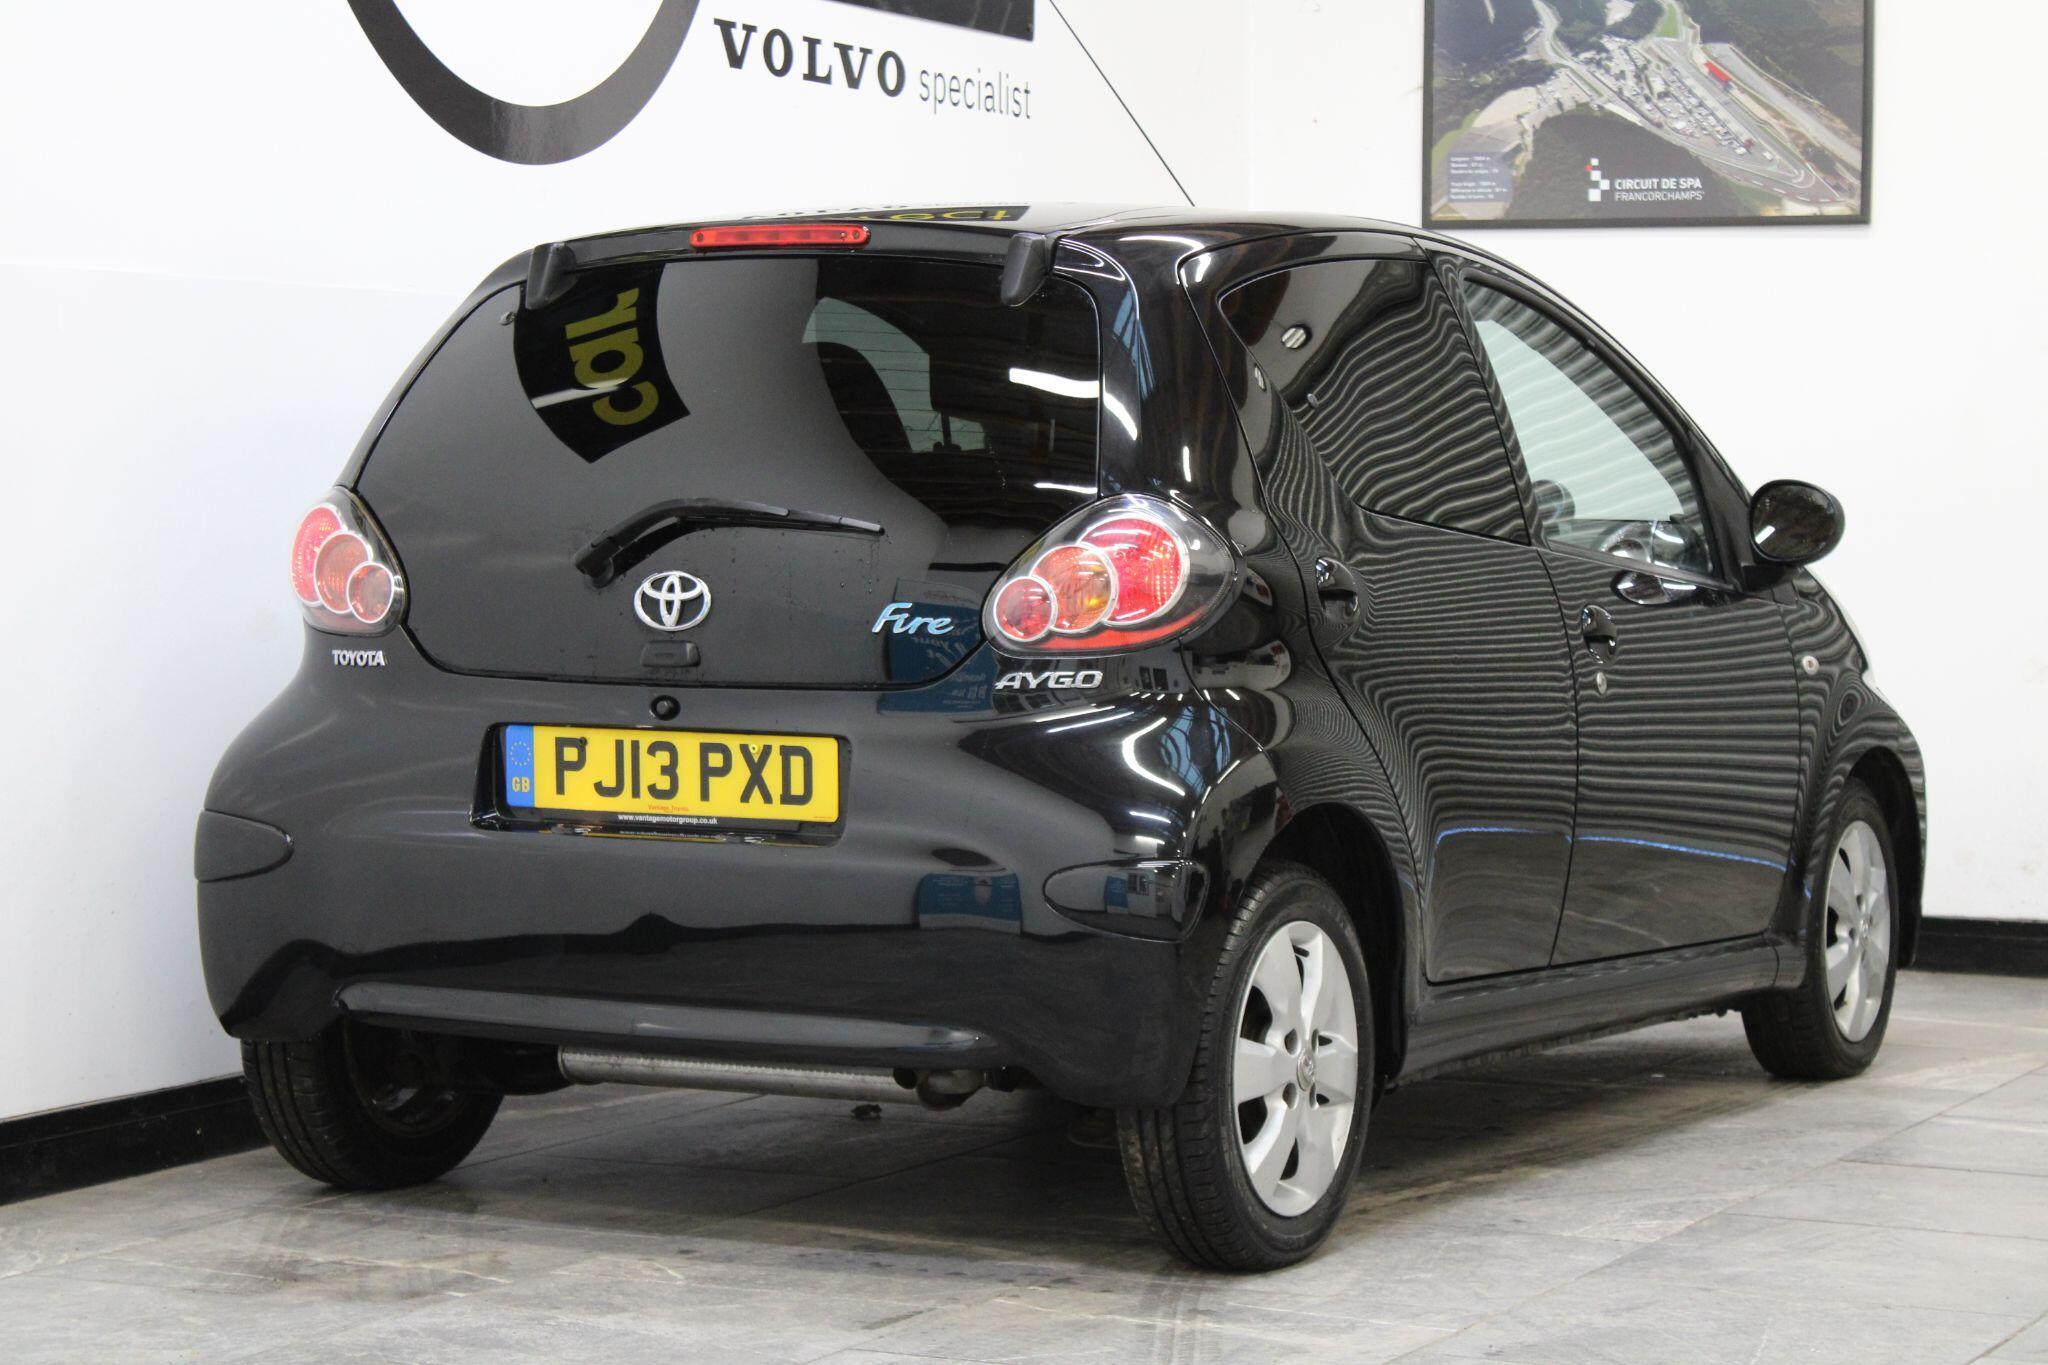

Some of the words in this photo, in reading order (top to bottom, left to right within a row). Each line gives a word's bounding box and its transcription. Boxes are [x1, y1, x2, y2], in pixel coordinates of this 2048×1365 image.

[713, 17, 906, 98] VOLVO
[918, 67, 1031, 120] specialist
[1614, 178, 1659, 190] CIRCUIT
[1661, 178, 1677, 189] DE
[1679, 177, 1703, 189] SPA
[1615, 190, 1703, 201] FRANCORCHAMPS
[871, 602, 953, 635] Fire
[331, 649, 386, 667] TOYOTA
[994, 670, 1103, 690] AYGO
[555, 736, 679, 801] PJ13
[699, 742, 813, 806] PXD
[511, 776, 530, 793] GB
[617, 814, 718, 825] www.vantagemotorgroup.co.uk
